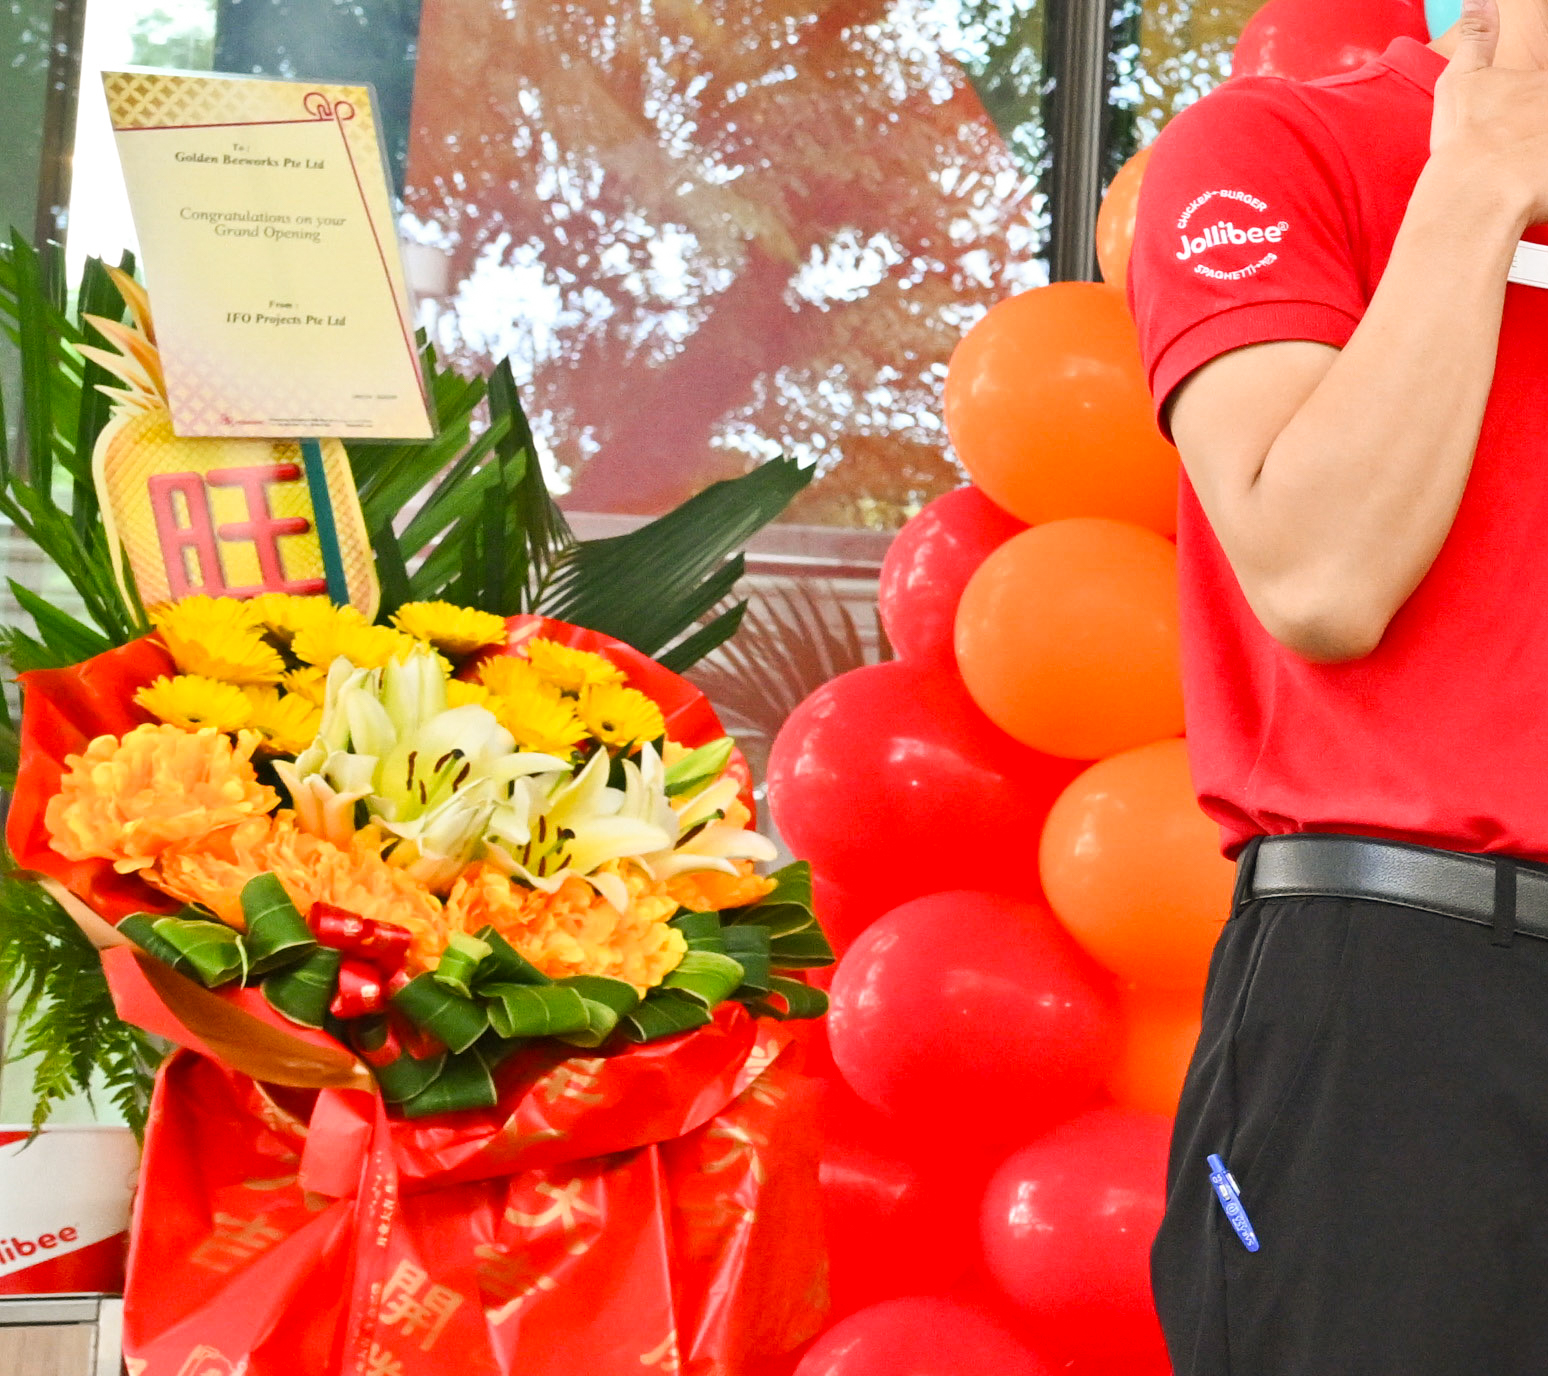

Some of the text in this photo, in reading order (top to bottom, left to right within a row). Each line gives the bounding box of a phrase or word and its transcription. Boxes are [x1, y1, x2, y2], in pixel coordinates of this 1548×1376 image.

[175, 151, 325, 170] Golden Beeworks Pte Ltd
[1177, 191, 1212, 229] CHICKEN
[1220, 190, 1267, 212] BURGER
[180, 207, 347, 228] Congratulations on your
[214, 224, 321, 243] Grand Opening
[1194, 264, 1257, 280] SPAGHETTI
[226, 312, 346, 326] IFO Projects Pte Ltd
[148, 463, 328, 600] 旺
